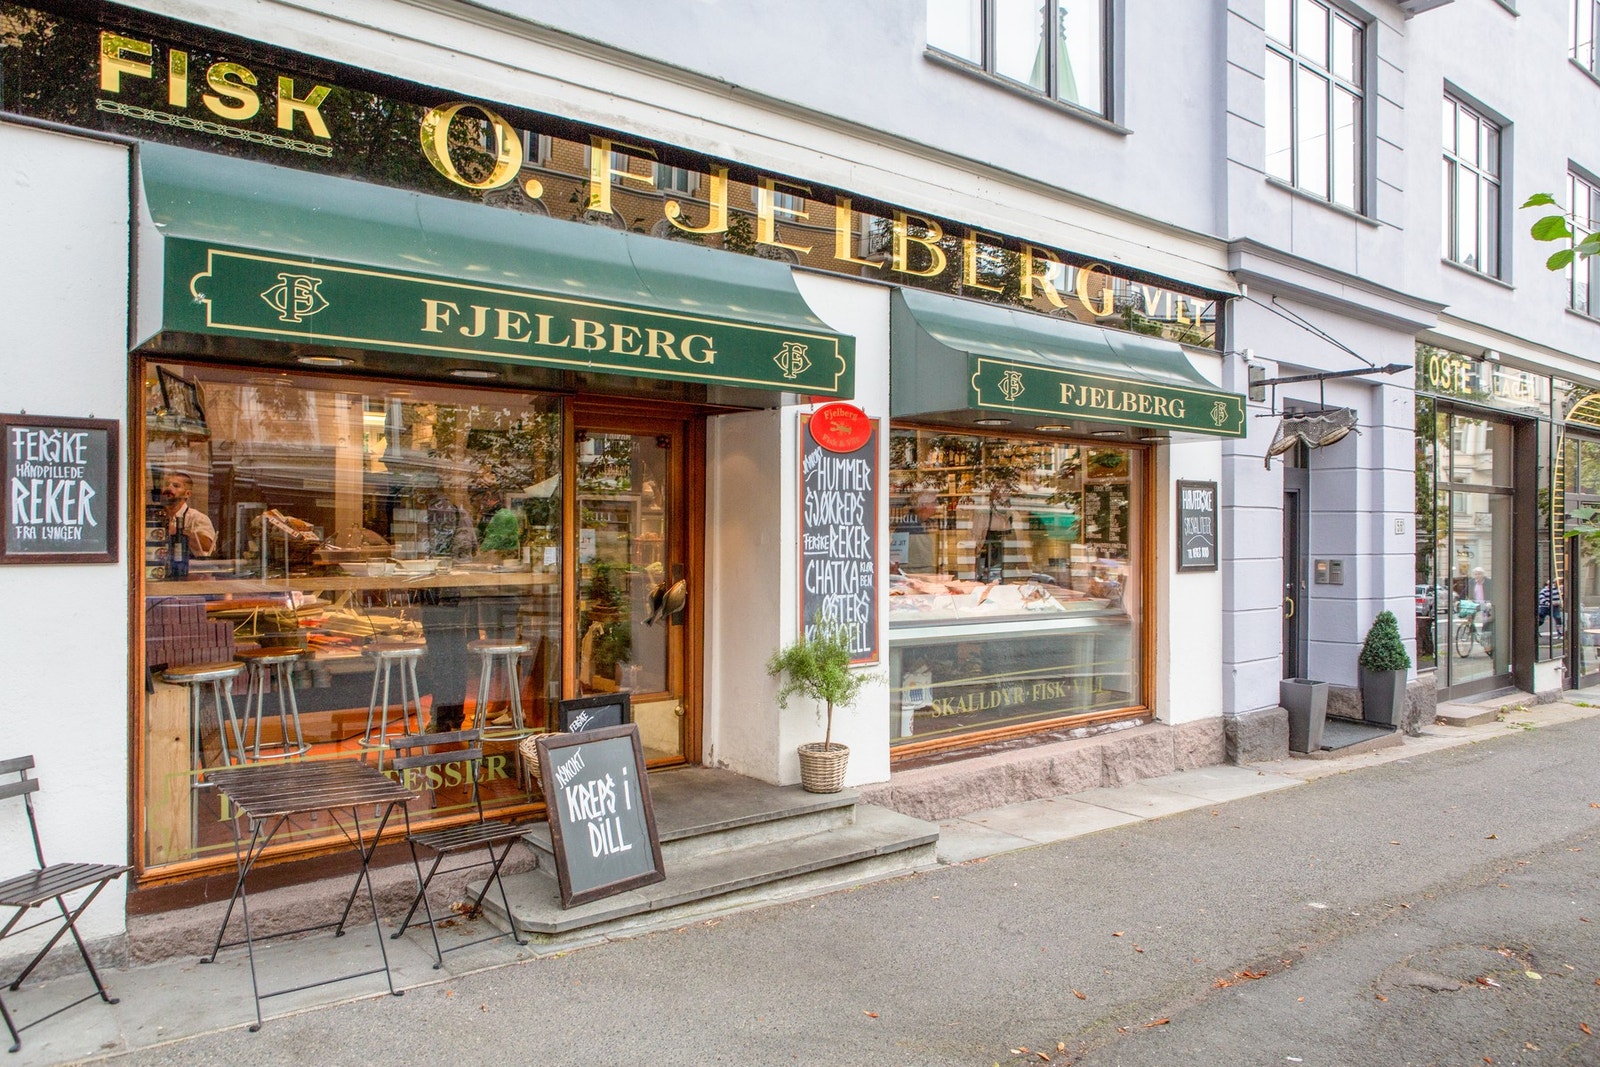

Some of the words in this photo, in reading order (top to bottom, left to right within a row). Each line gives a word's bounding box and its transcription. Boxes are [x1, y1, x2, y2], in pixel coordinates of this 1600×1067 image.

[100, 31, 332, 139] FISK
[419, 101, 544, 199] O.
[590, 135, 1115, 318] FJELBERG
[1142, 285, 1206, 327] VILT
[420, 298, 717, 365] FJELBERG
[1429, 354, 1472, 394] OSTE
[823, 407, 859, 421] Fjelberg
[1059, 382, 1186, 419] FJELBERG
[12, 428, 89, 465] FERSKE
[818, 457, 872, 491] HUMMER
[11, 477, 98, 527] REKER
[804, 487, 866, 527] SJØKREPS
[15, 525, 37, 540] FRA
[42, 526, 83, 541] LYNGEN
[829, 524, 872, 559] REKER
[805, 559, 860, 594] CHATKA
[821, 590, 870, 624] ØSTERS
[931, 685, 1025, 718] SKALLDYR
[1031, 681, 1067, 702] FISK
[566, 773, 616, 823] KREPS
